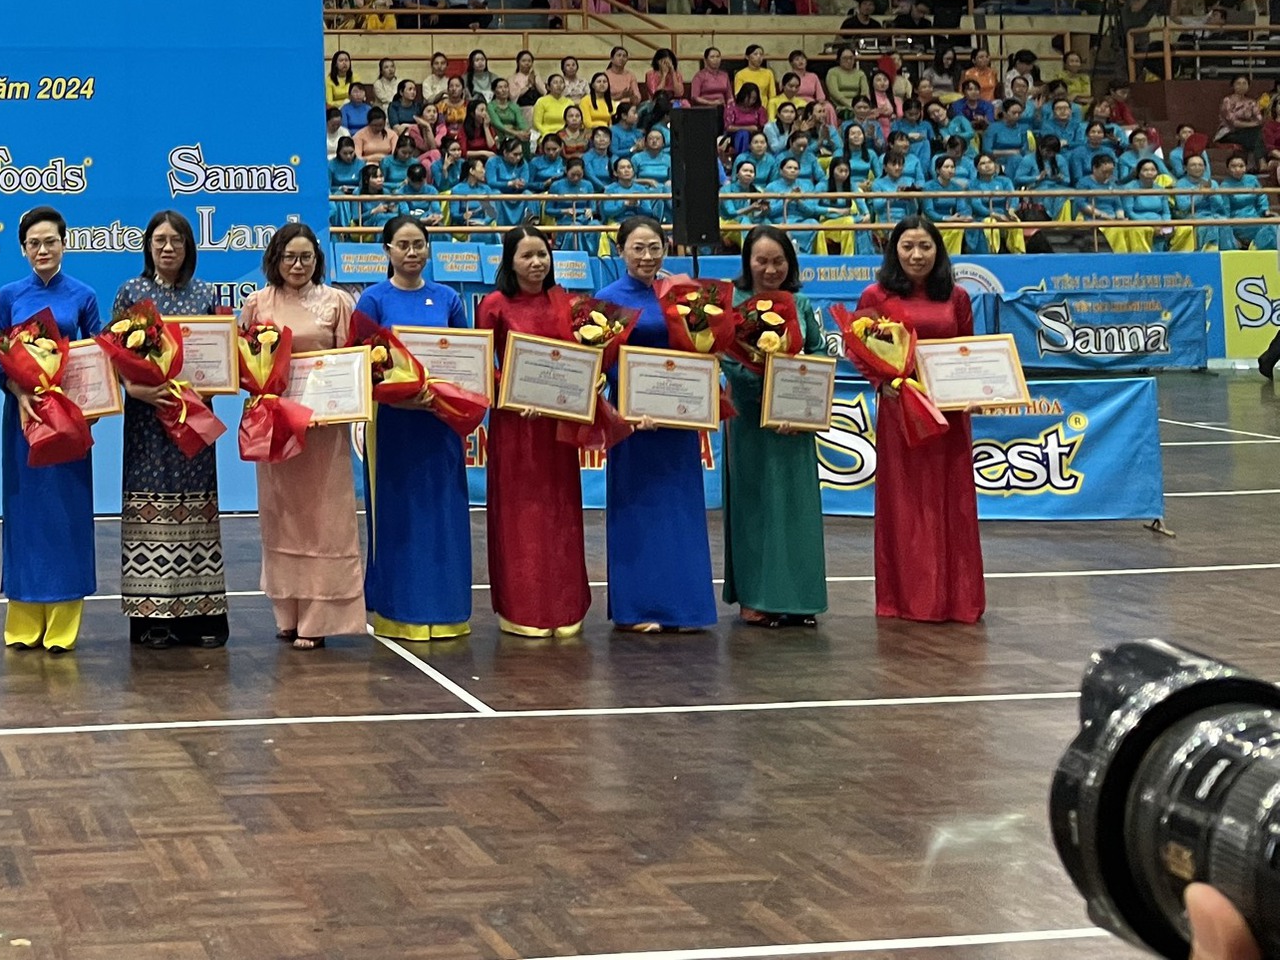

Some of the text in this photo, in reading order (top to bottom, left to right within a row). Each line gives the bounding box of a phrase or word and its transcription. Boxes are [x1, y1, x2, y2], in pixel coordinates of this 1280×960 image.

[36, 76, 96, 101] 2024
[168, 142, 299, 198] Sanna
[196, 206, 301, 252] Lan
[1036, 299, 1170, 358] Sanna
